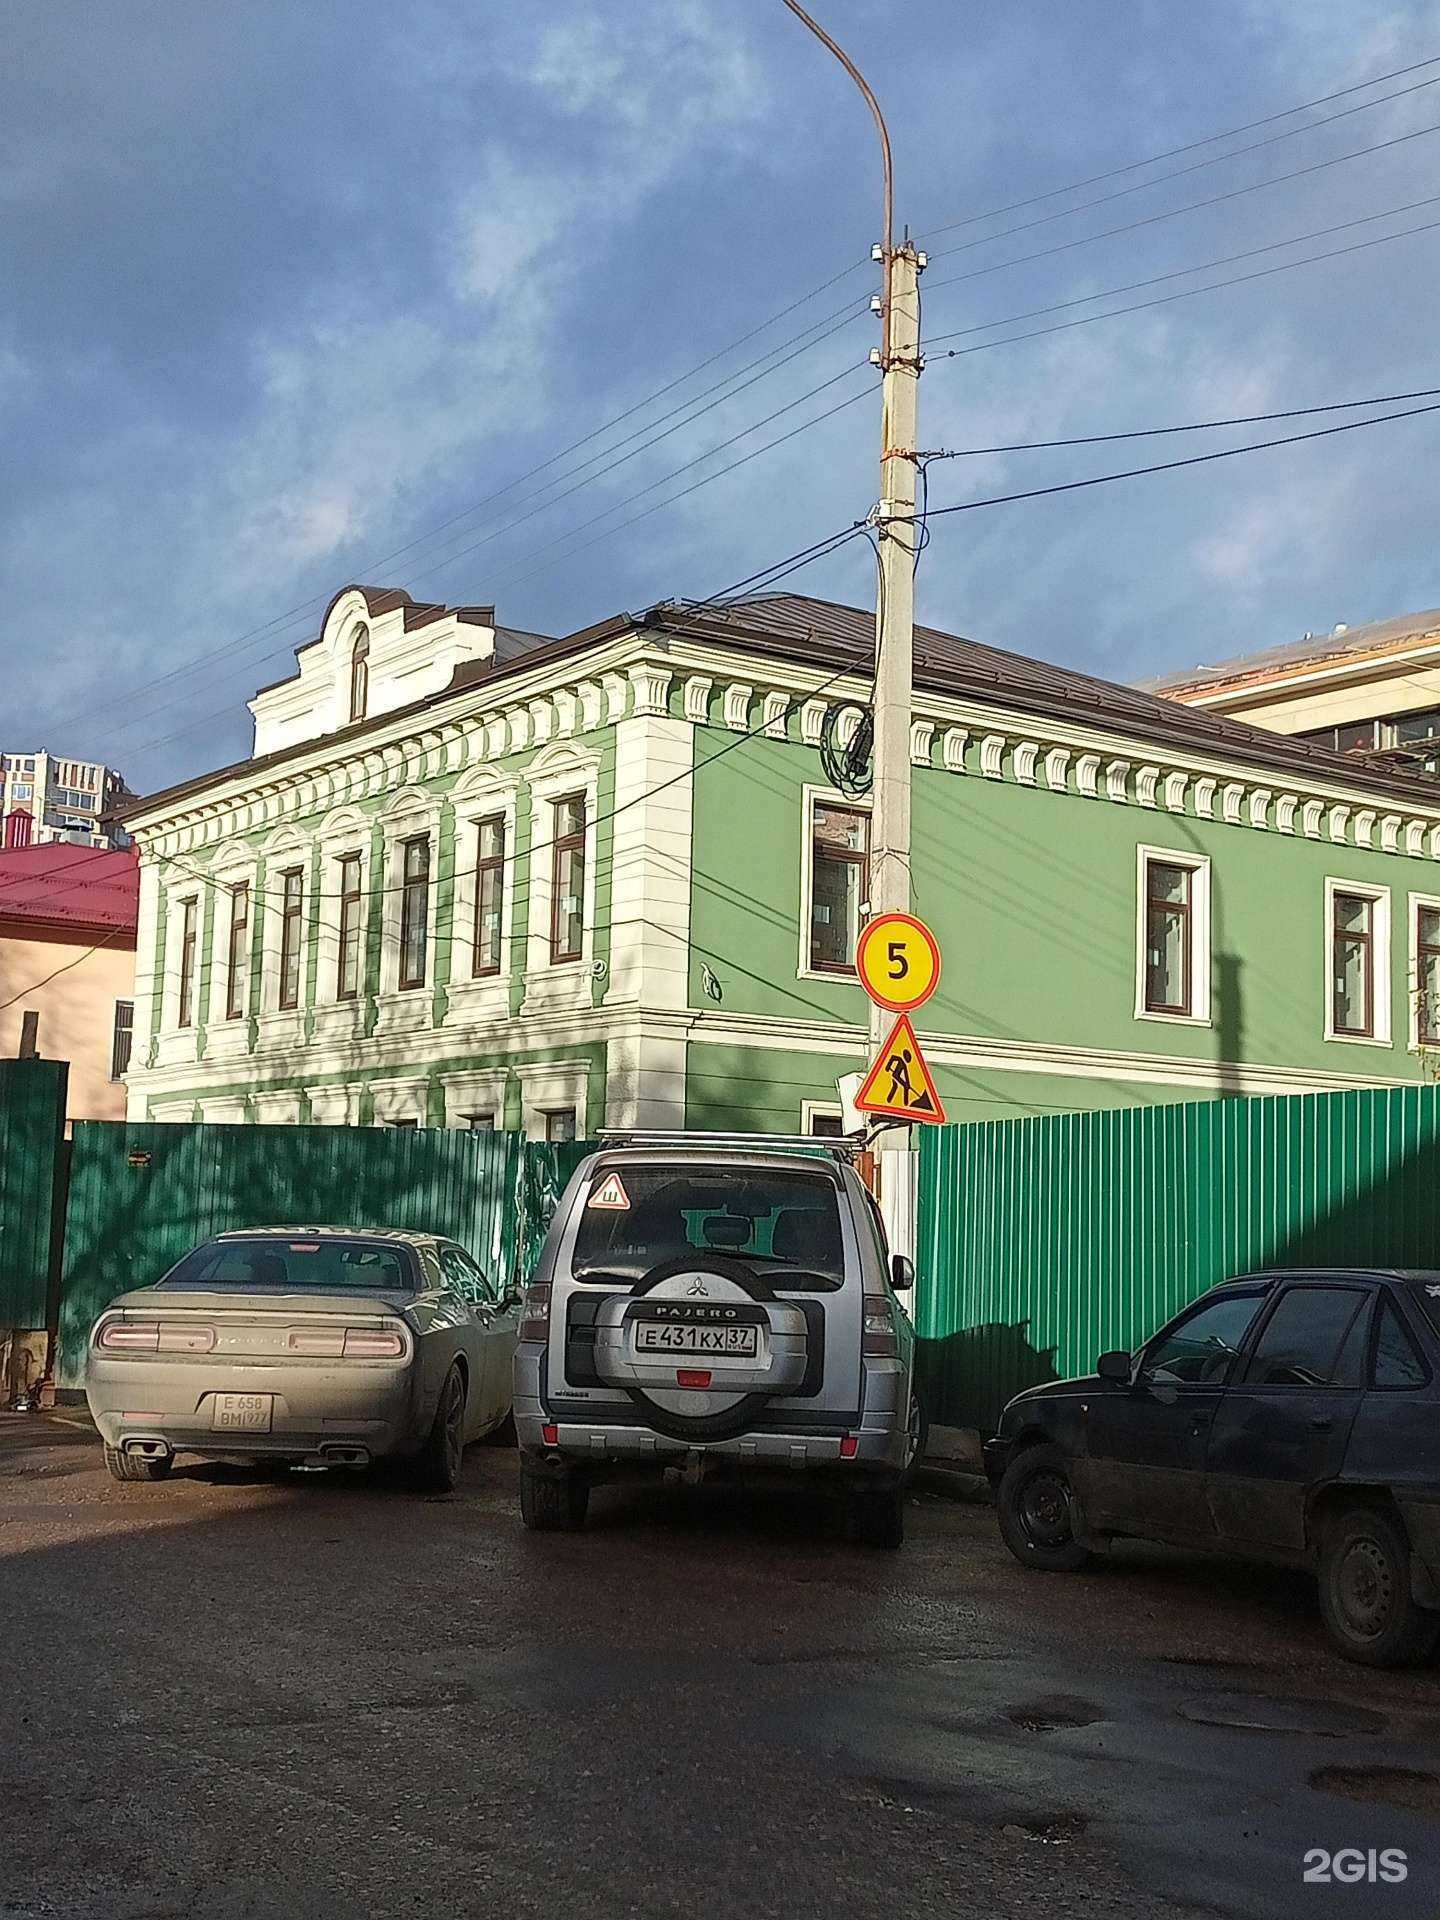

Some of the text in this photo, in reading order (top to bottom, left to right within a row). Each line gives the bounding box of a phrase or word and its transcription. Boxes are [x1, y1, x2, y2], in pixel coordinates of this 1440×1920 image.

[888, 943, 908, 979] 5
[603, 1192, 617, 1202] Ш
[656, 1307, 737, 1318] PAJERO
